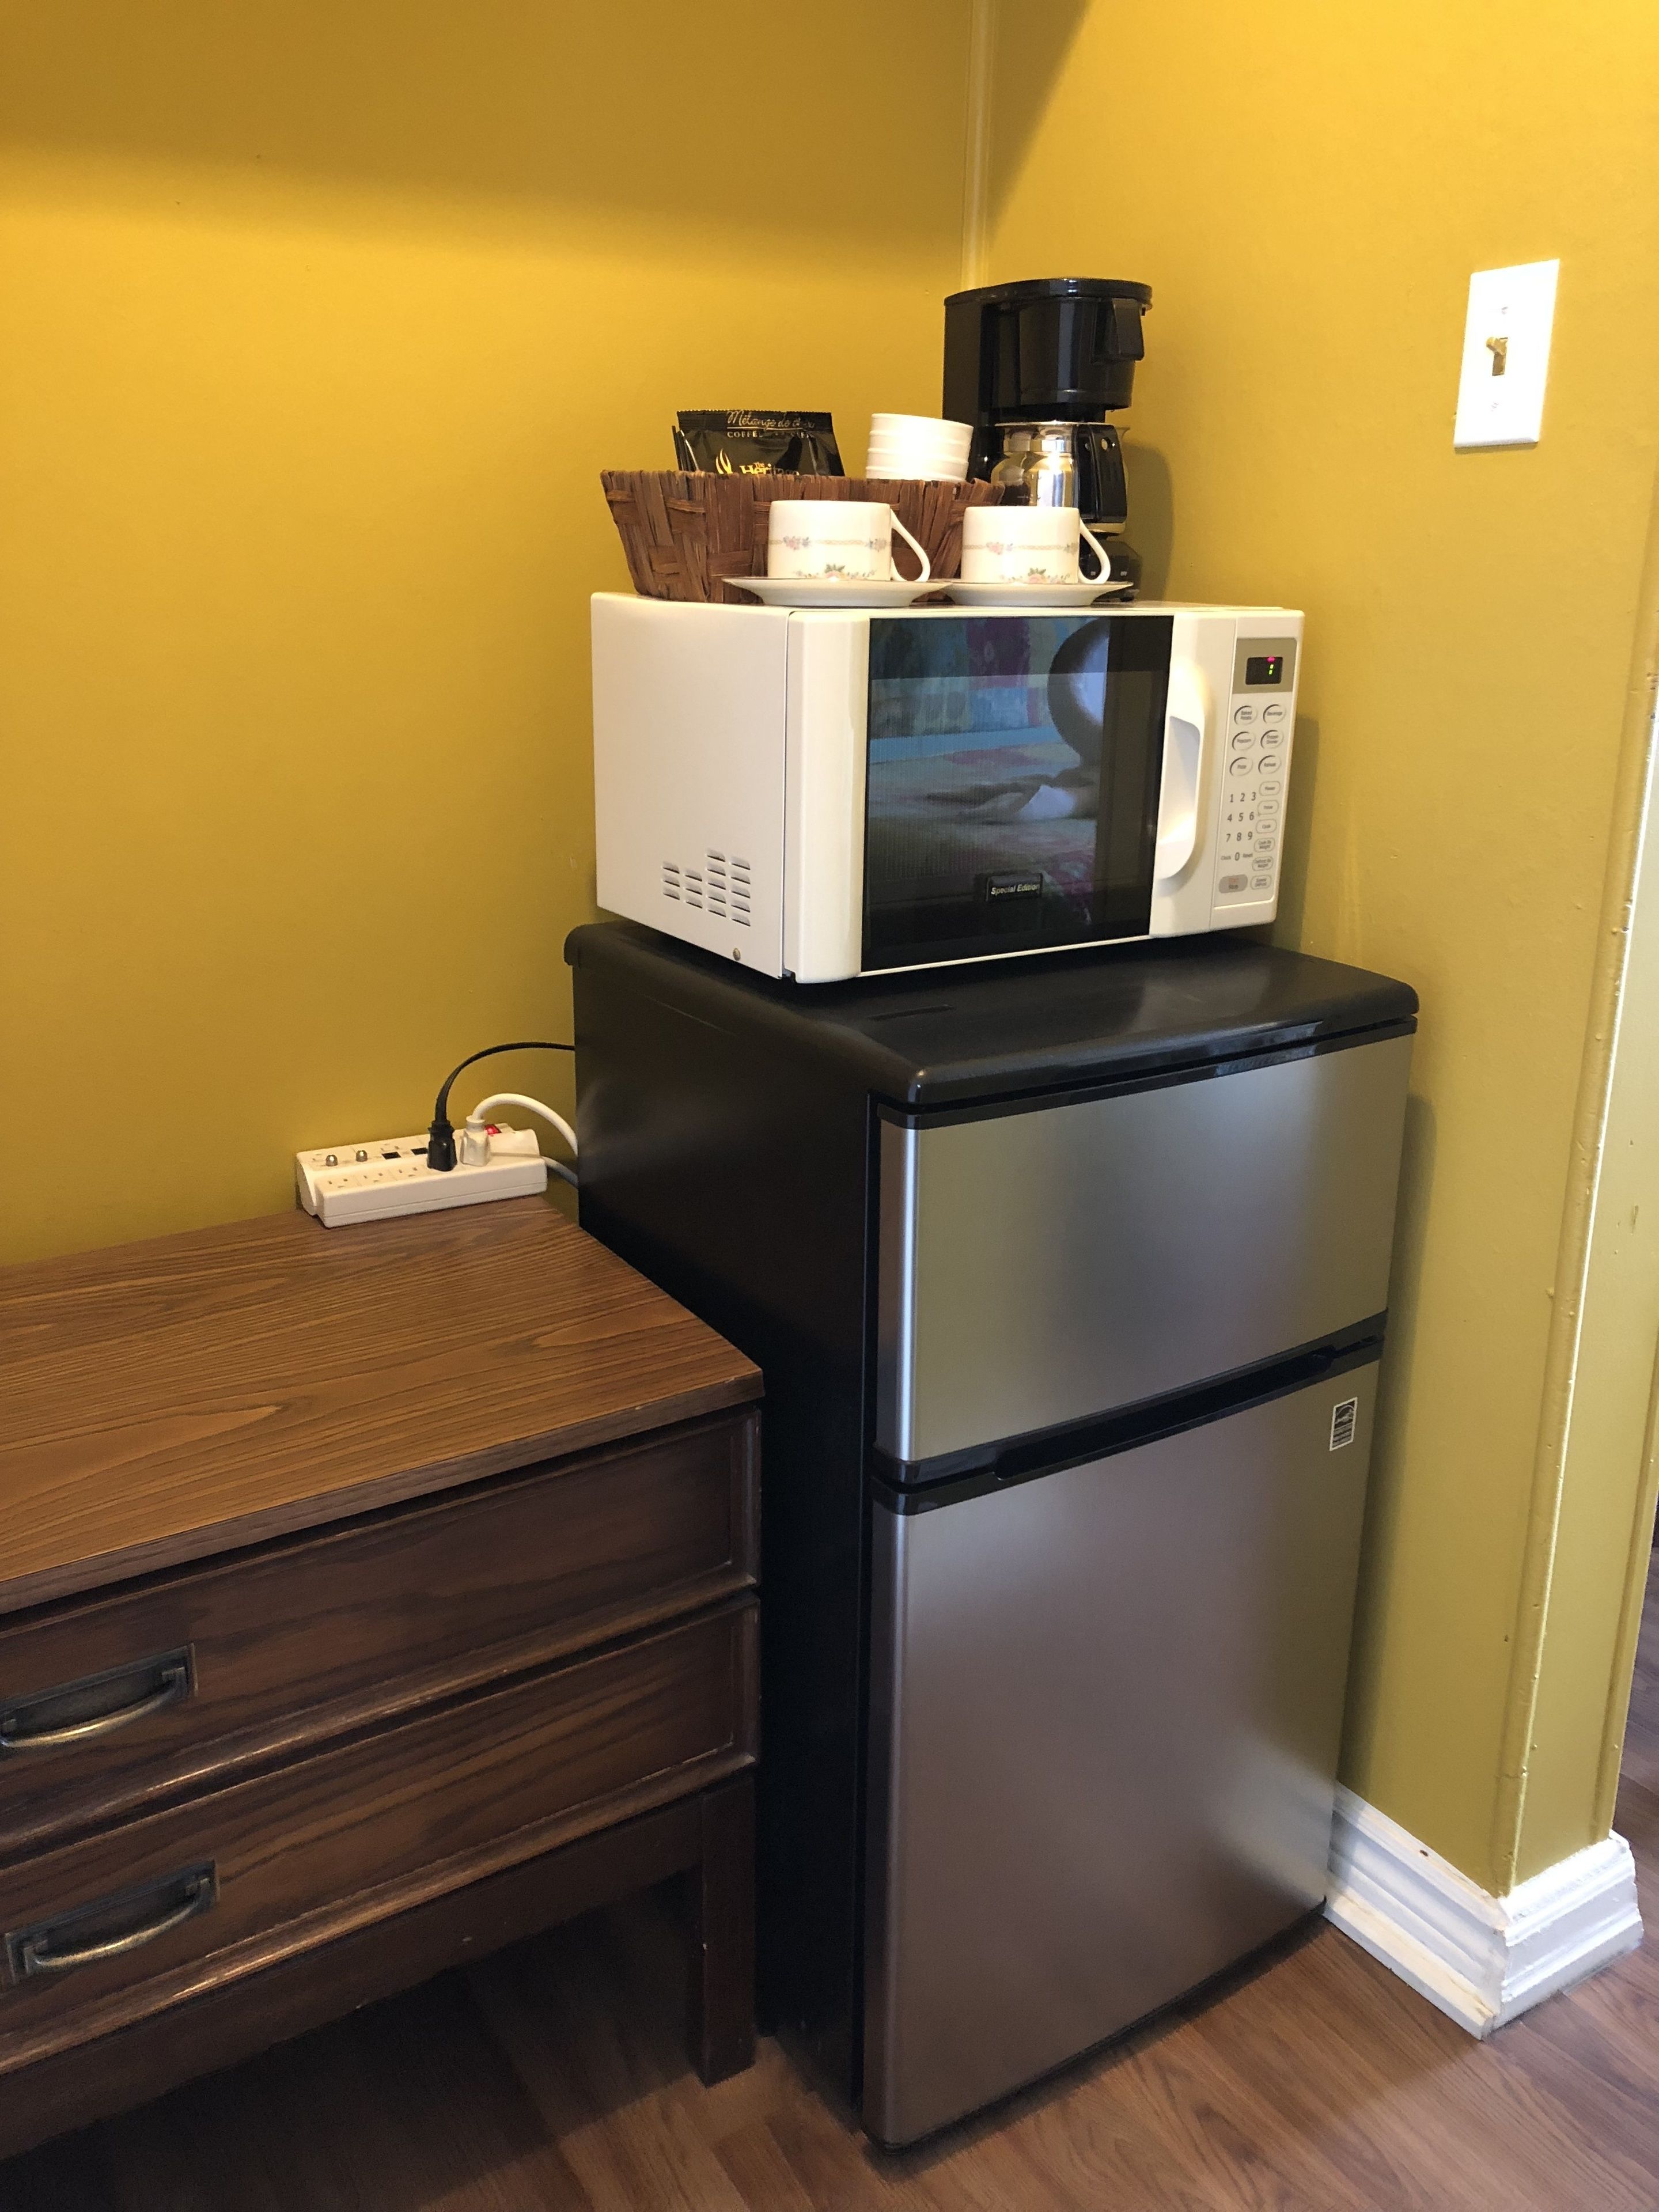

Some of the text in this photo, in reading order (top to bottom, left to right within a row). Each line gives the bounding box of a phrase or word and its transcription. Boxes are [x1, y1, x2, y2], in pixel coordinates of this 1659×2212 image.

[1229, 791, 1256, 802] 1 2 3
[1227, 811, 1254, 822] 4 5 6
[1226, 831, 1253, 842] 7 8 9
[1234, 852, 1240, 861] 0
[991, 884, 1040, 896] Special Edition
